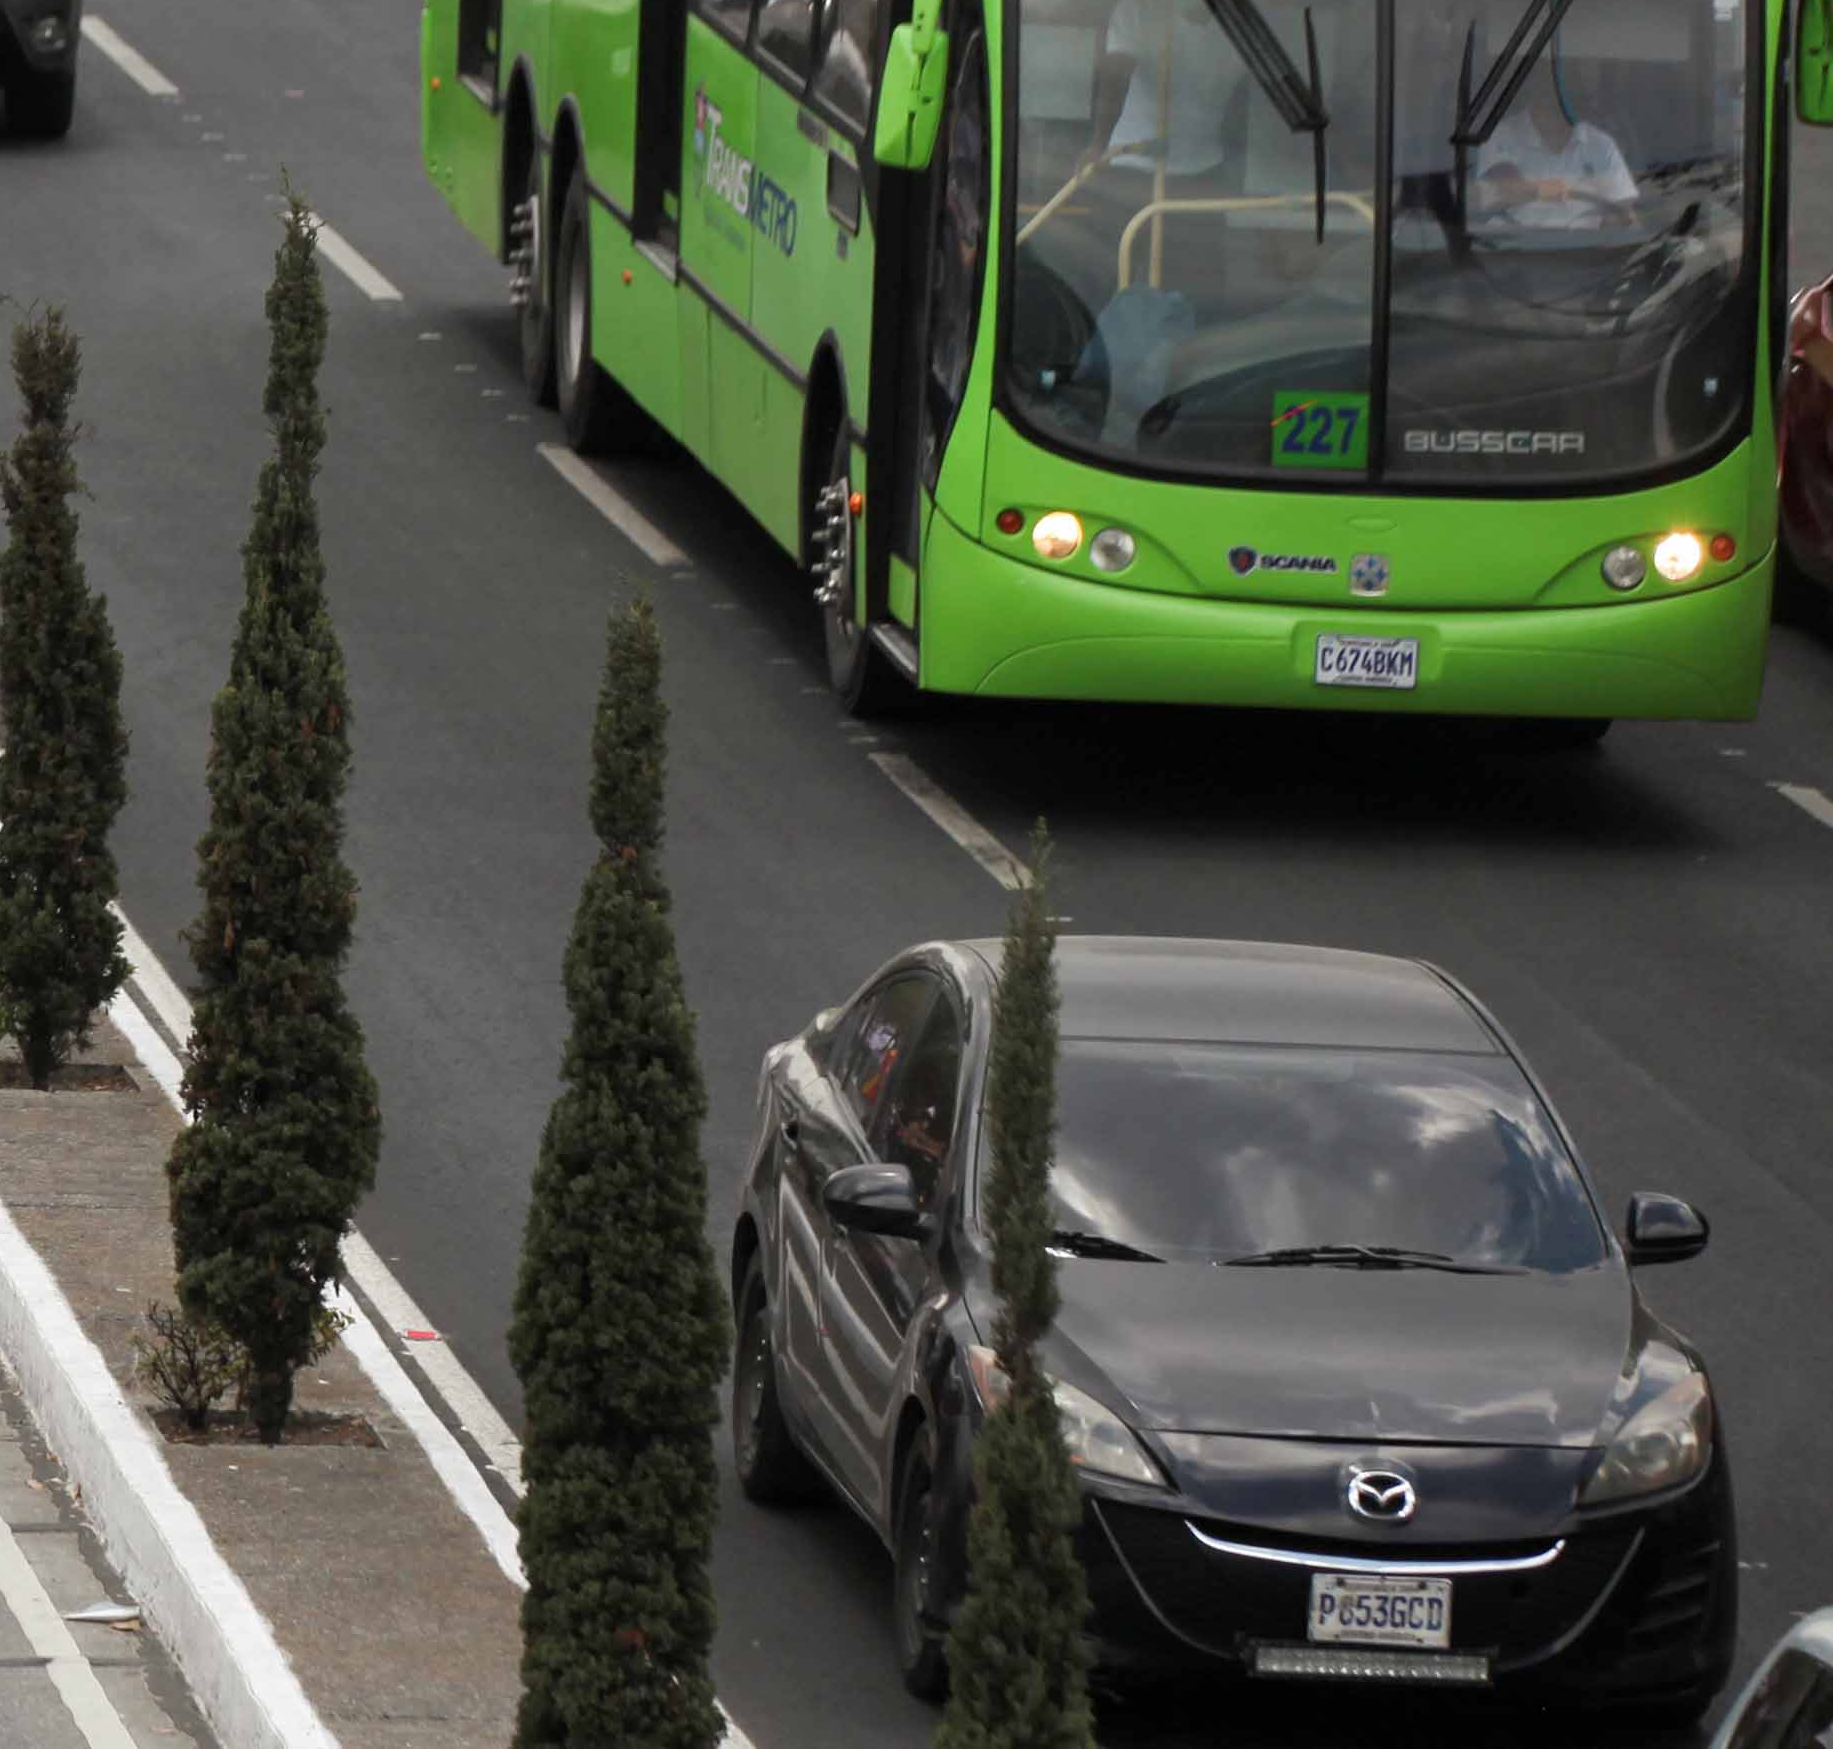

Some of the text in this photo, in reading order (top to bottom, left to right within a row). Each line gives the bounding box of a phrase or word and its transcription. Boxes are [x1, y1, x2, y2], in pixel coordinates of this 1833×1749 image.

[1281, 405, 1362, 455] 227
[1404, 430, 1586, 454] BUSSCAR
[1260, 553, 1337, 573] SCANIA
[1320, 646, 1415, 678] C674BKM
